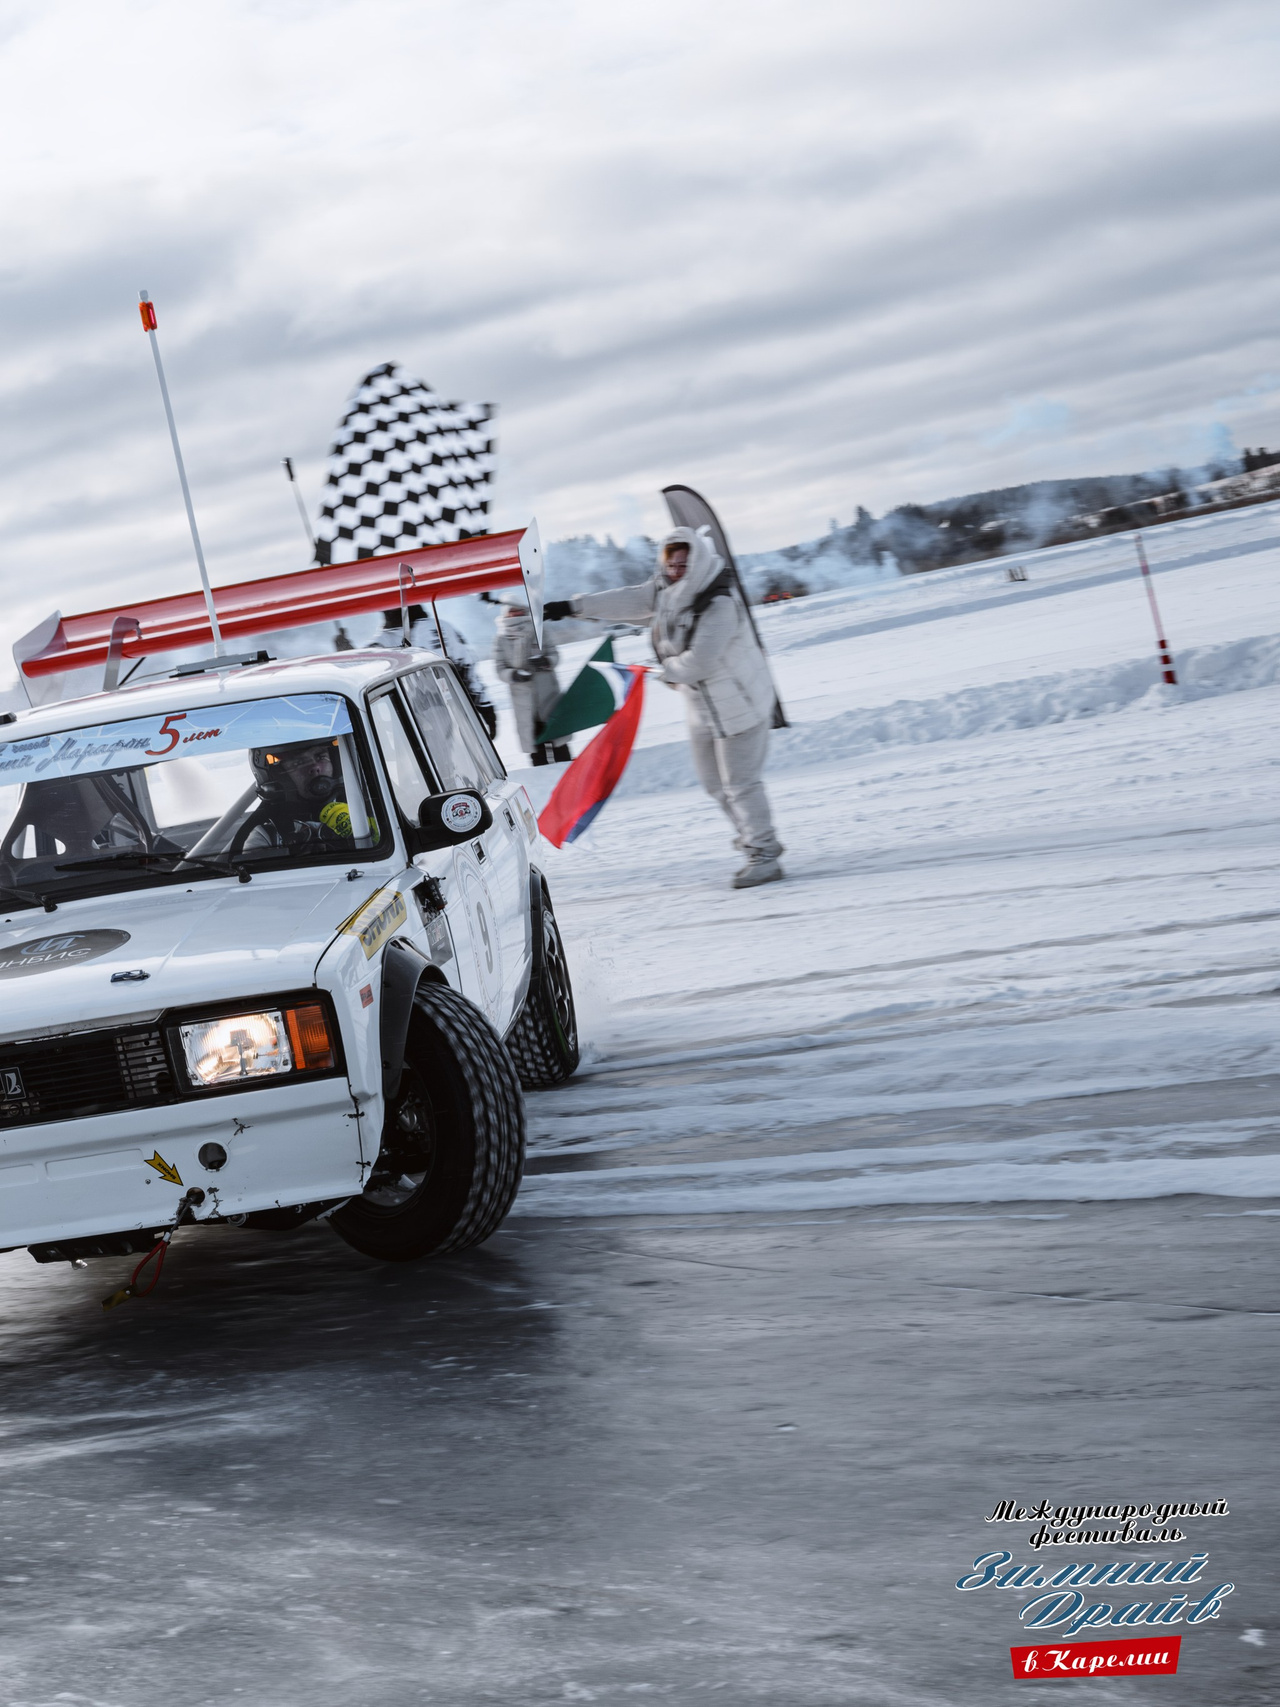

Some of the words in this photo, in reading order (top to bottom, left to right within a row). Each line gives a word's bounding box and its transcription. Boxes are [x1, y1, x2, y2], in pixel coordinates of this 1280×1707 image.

[35, 737, 152, 773] Марафон
[145, 713, 187, 755] 5
[182, 728, 222, 744] лет
[476, 901, 494, 975] 9
